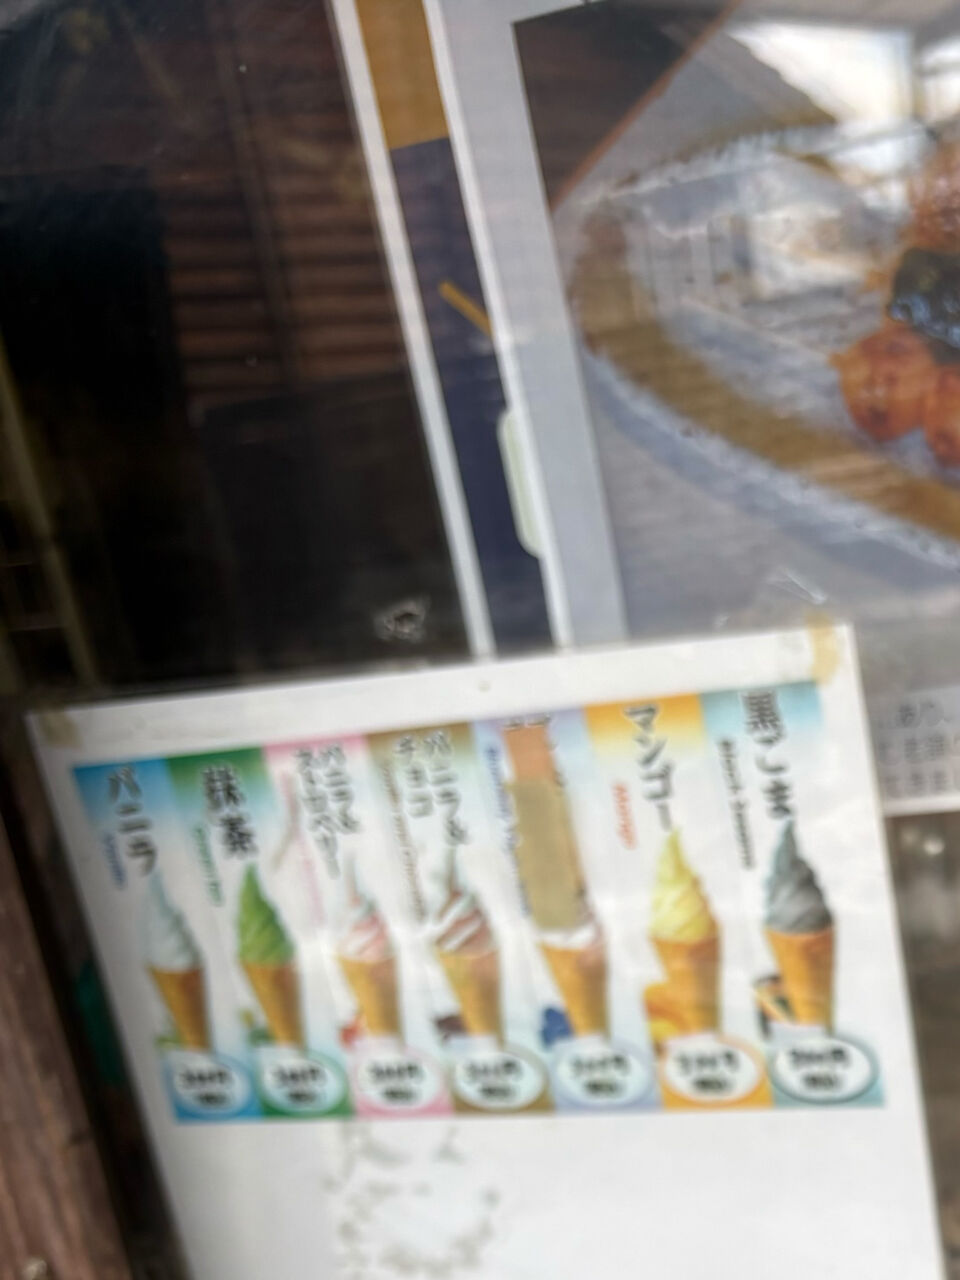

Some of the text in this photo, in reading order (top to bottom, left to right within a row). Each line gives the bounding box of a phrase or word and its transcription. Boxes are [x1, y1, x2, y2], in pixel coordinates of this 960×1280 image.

[107, 765, 158, 877] バニラ
[623, 704, 674, 831] マンゴー
